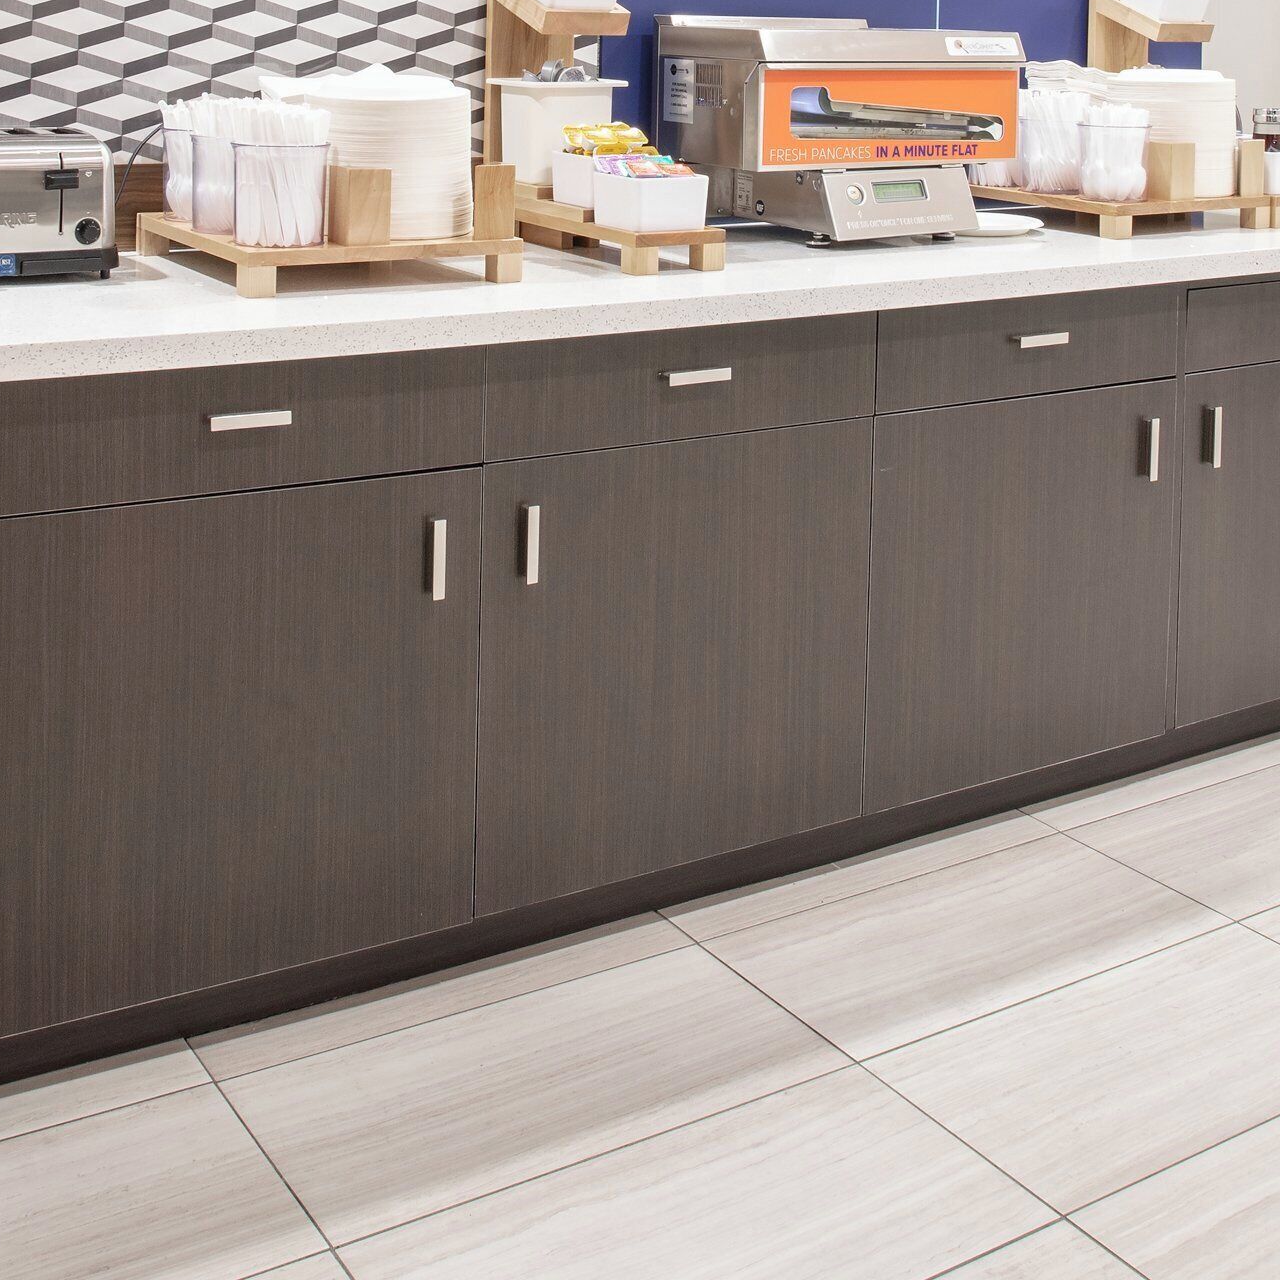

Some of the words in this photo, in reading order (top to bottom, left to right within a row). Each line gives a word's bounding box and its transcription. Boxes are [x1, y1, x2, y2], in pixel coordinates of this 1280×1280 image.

[770, 147, 807, 162] FRESH
[811, 146, 871, 160] PANCAKES
[876, 146, 889, 158] IN
[892, 145, 901, 158] A
[904, 145, 948, 157] MINUTE
[951, 144, 978, 156] FLAT
